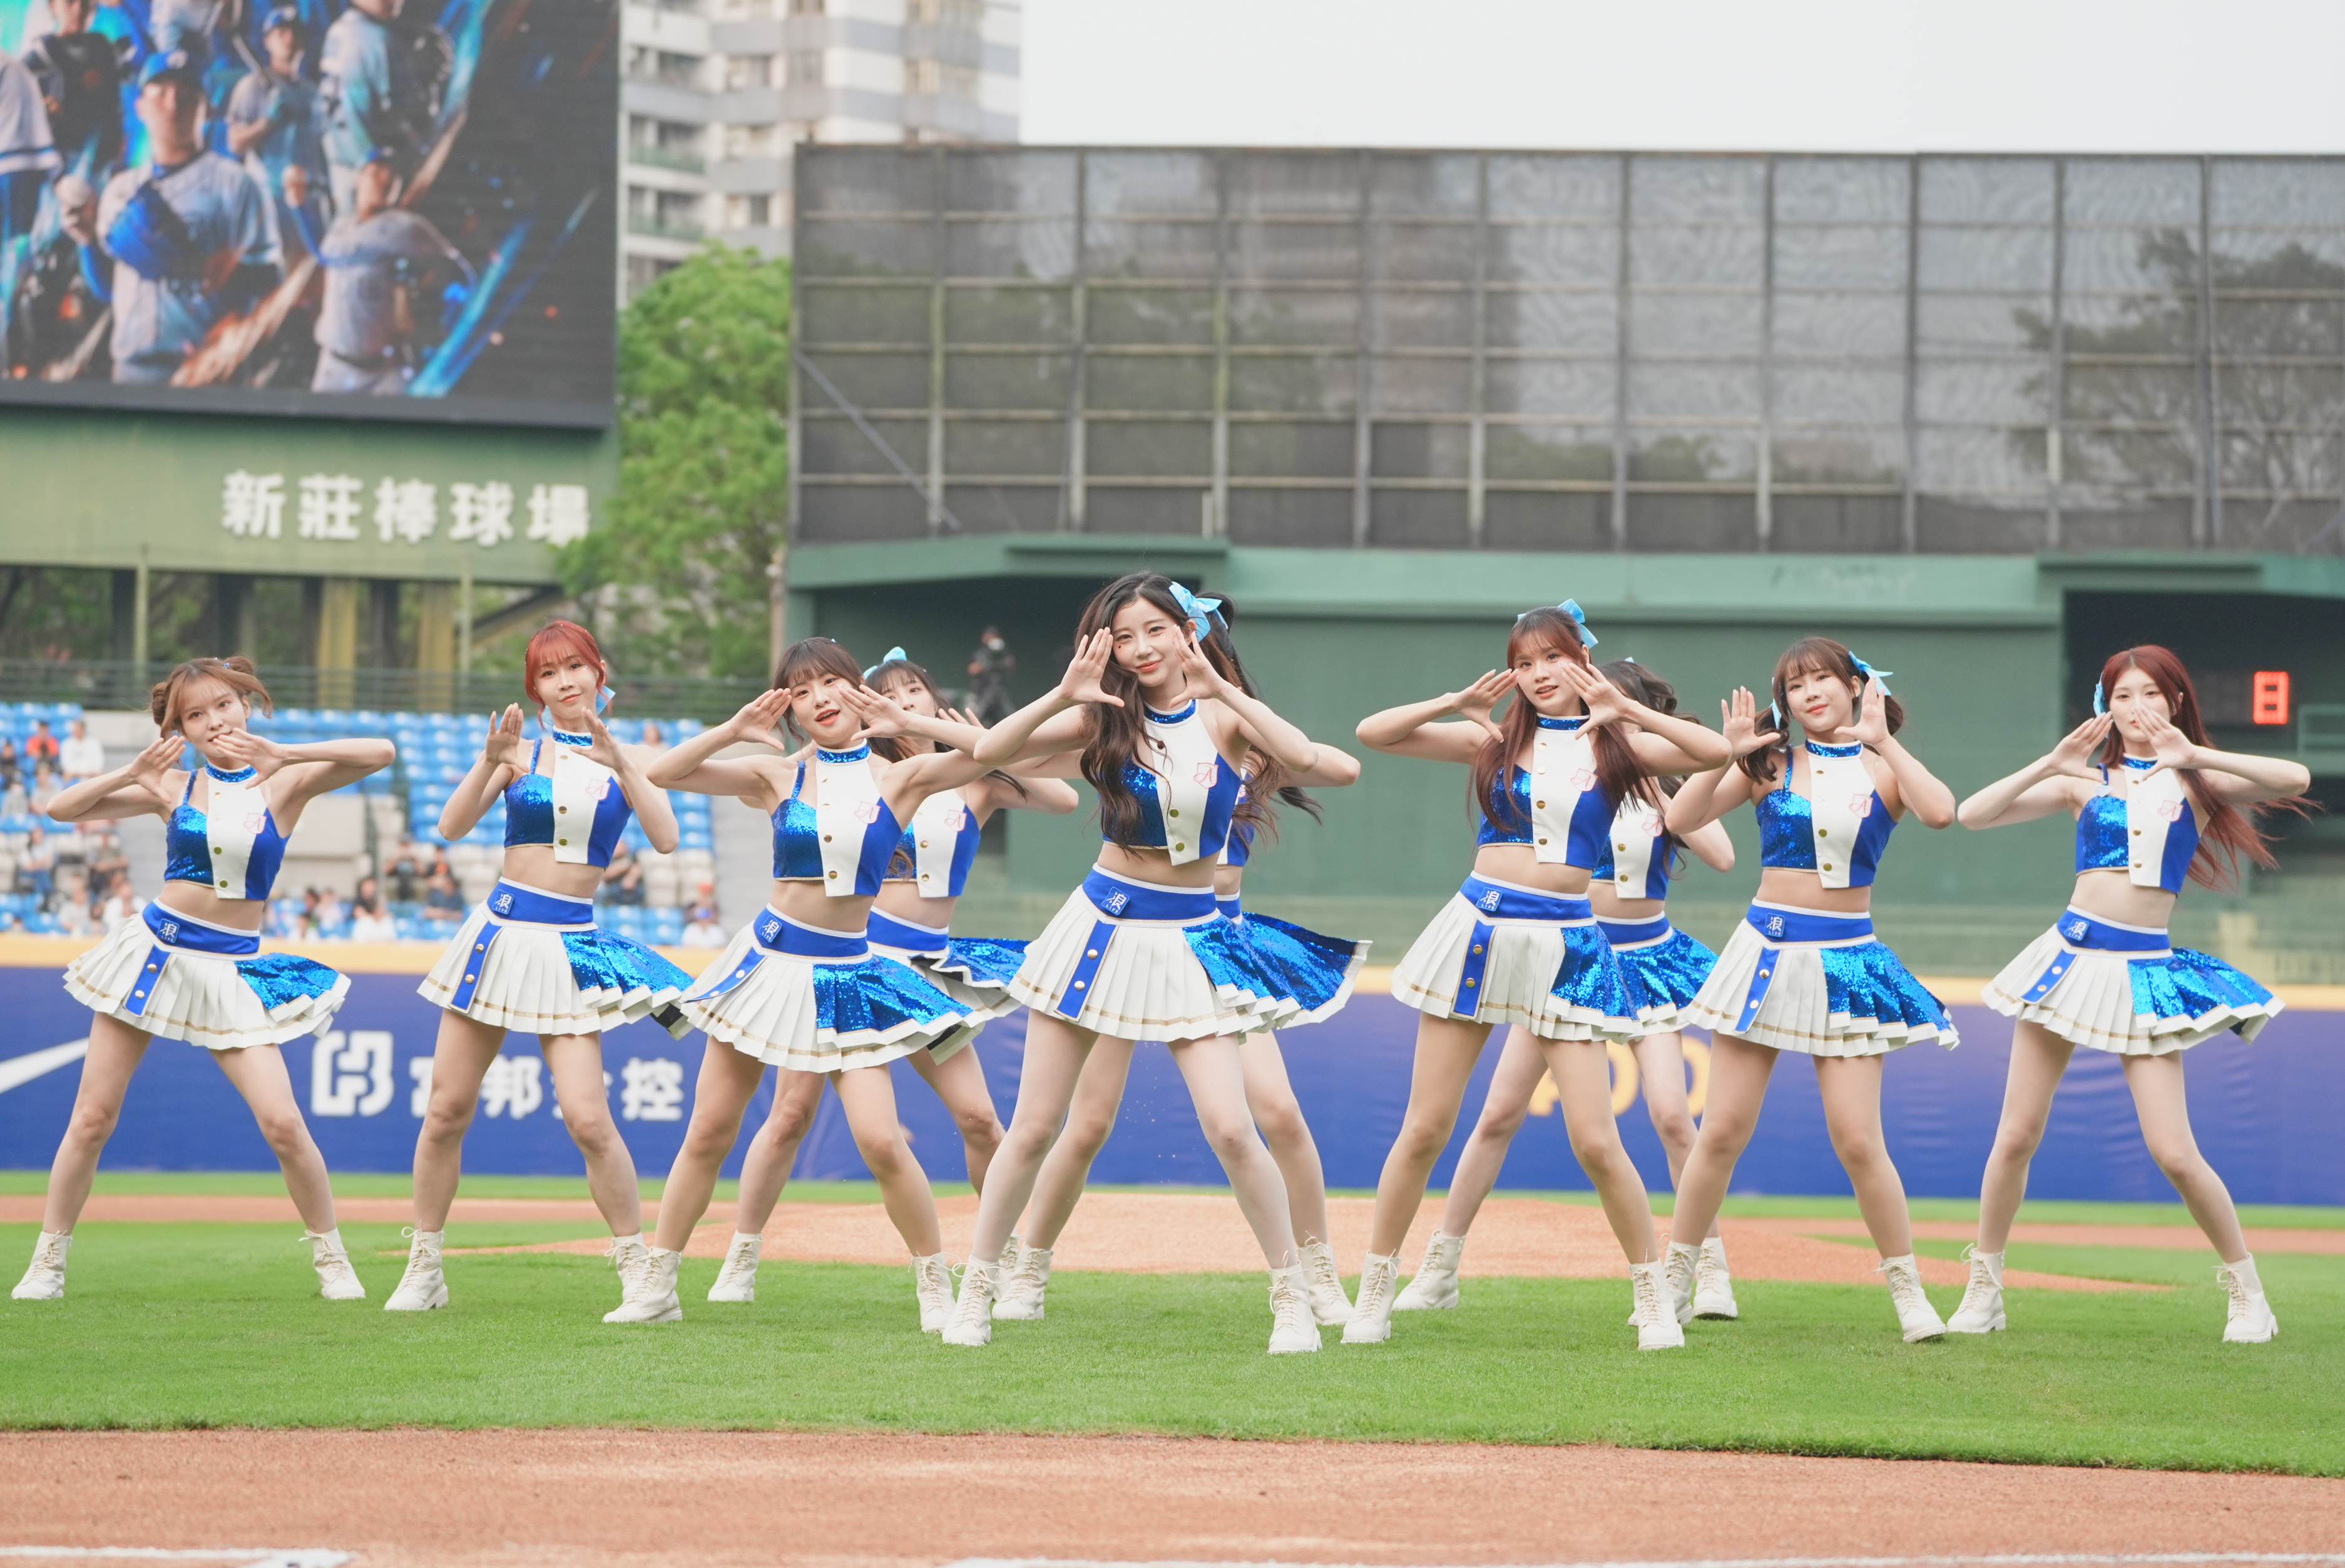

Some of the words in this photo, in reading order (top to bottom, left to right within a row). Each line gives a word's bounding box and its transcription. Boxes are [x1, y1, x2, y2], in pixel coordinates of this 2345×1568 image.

[222, 469, 590, 547] 新莊棒球場
[2254, 671, 2289, 725] 8
[495, 893, 512, 909] 浪
[1106, 892, 1127, 910] 浪
[1480, 890, 1500, 906] 浪
[160, 922, 177, 937] 浪
[762, 919, 780, 937] 浪
[1766, 916, 1783, 931] 浪
[2068, 921, 2087, 936] 浪
[410, 1054, 685, 1121] 邦控
